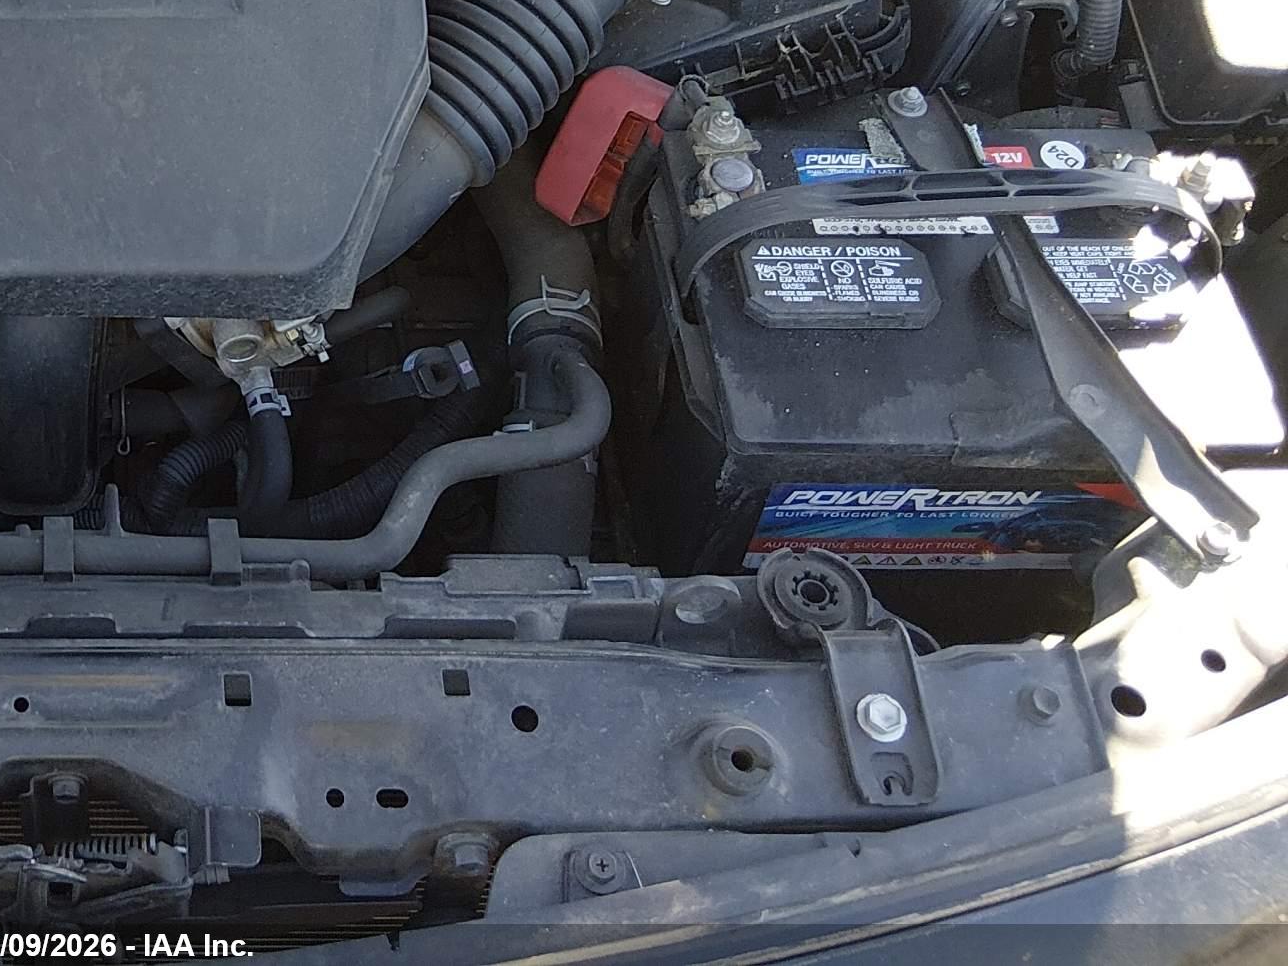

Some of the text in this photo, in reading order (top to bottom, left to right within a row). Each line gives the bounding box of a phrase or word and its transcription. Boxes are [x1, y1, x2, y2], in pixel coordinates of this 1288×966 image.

[992, 152, 1023, 164] 12V
[1047, 144, 1081, 169] D24
[771, 246, 901, 257] DANGER / POISON
[904, 277, 923, 285] ACID
[782, 488, 1043, 511] POWERTRON
[819, 511, 890, 519] TOUGHER
[895, 511, 912, 519] TO
[913, 511, 954, 519] LAST
[961, 511, 1020, 519] LONGER
[762, 541, 977, 550] AUTOMOTIVE, SUV & LIGHT TRUCK
